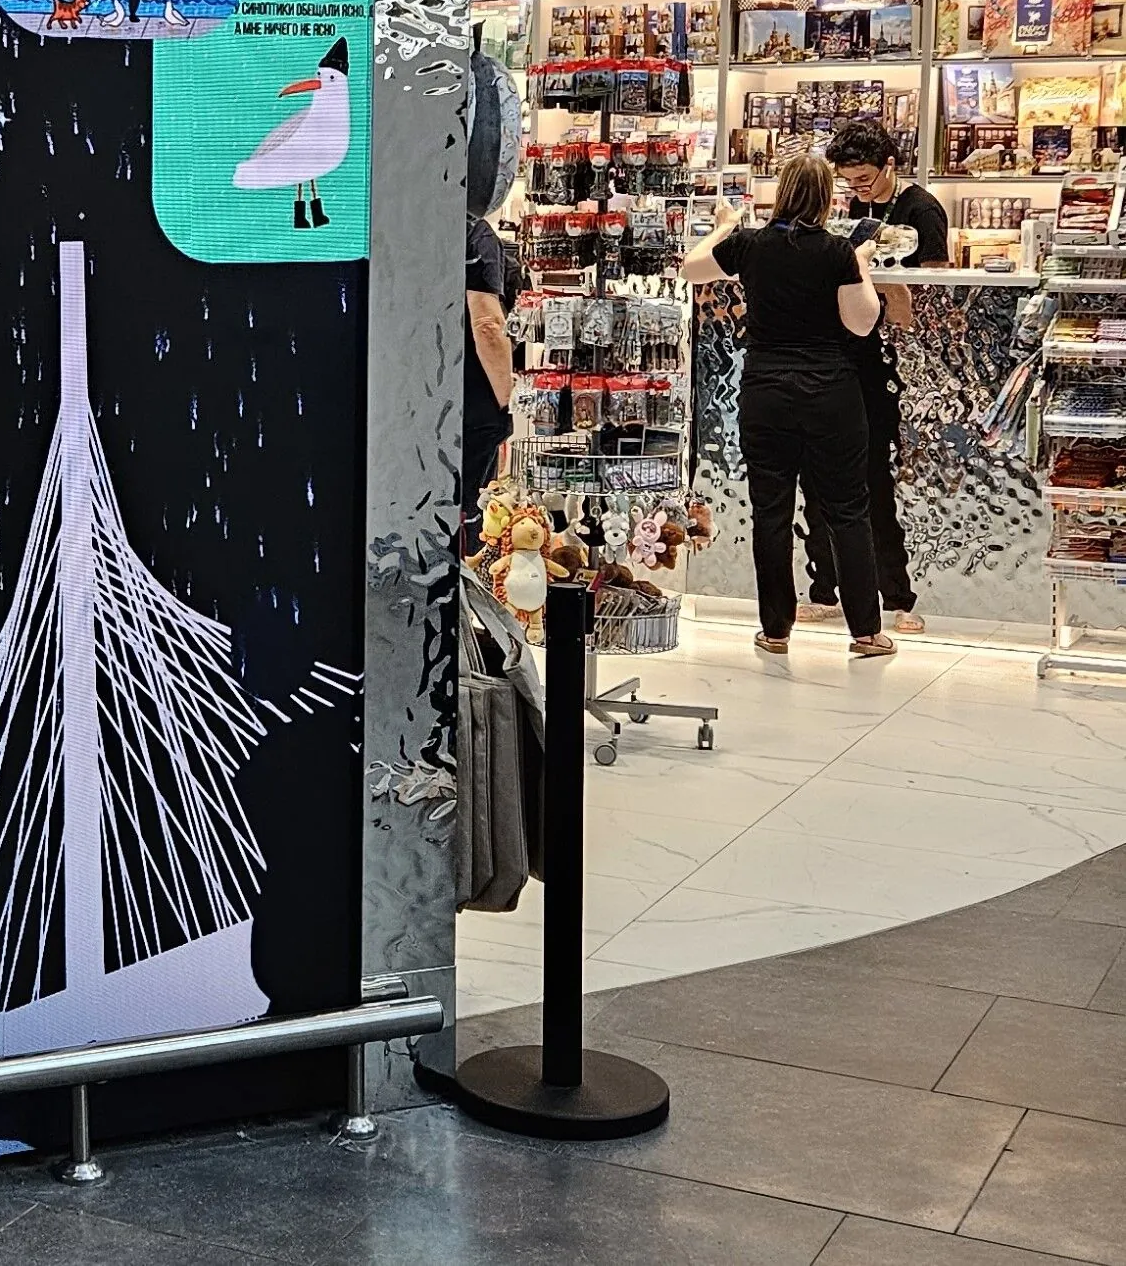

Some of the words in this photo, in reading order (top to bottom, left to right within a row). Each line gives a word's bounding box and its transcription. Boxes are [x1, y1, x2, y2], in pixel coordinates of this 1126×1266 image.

[241, 2, 295, 15] СИНОПТИКИ
[296, 3, 341, 18] ОБЕЩАЛИ
[243, 22, 262, 35] МНЕ
[264, 22, 298, 35] НИЧЕГО
[300, 23, 312, 36] НЕ
[314, 23, 336, 37] ЯСНО
